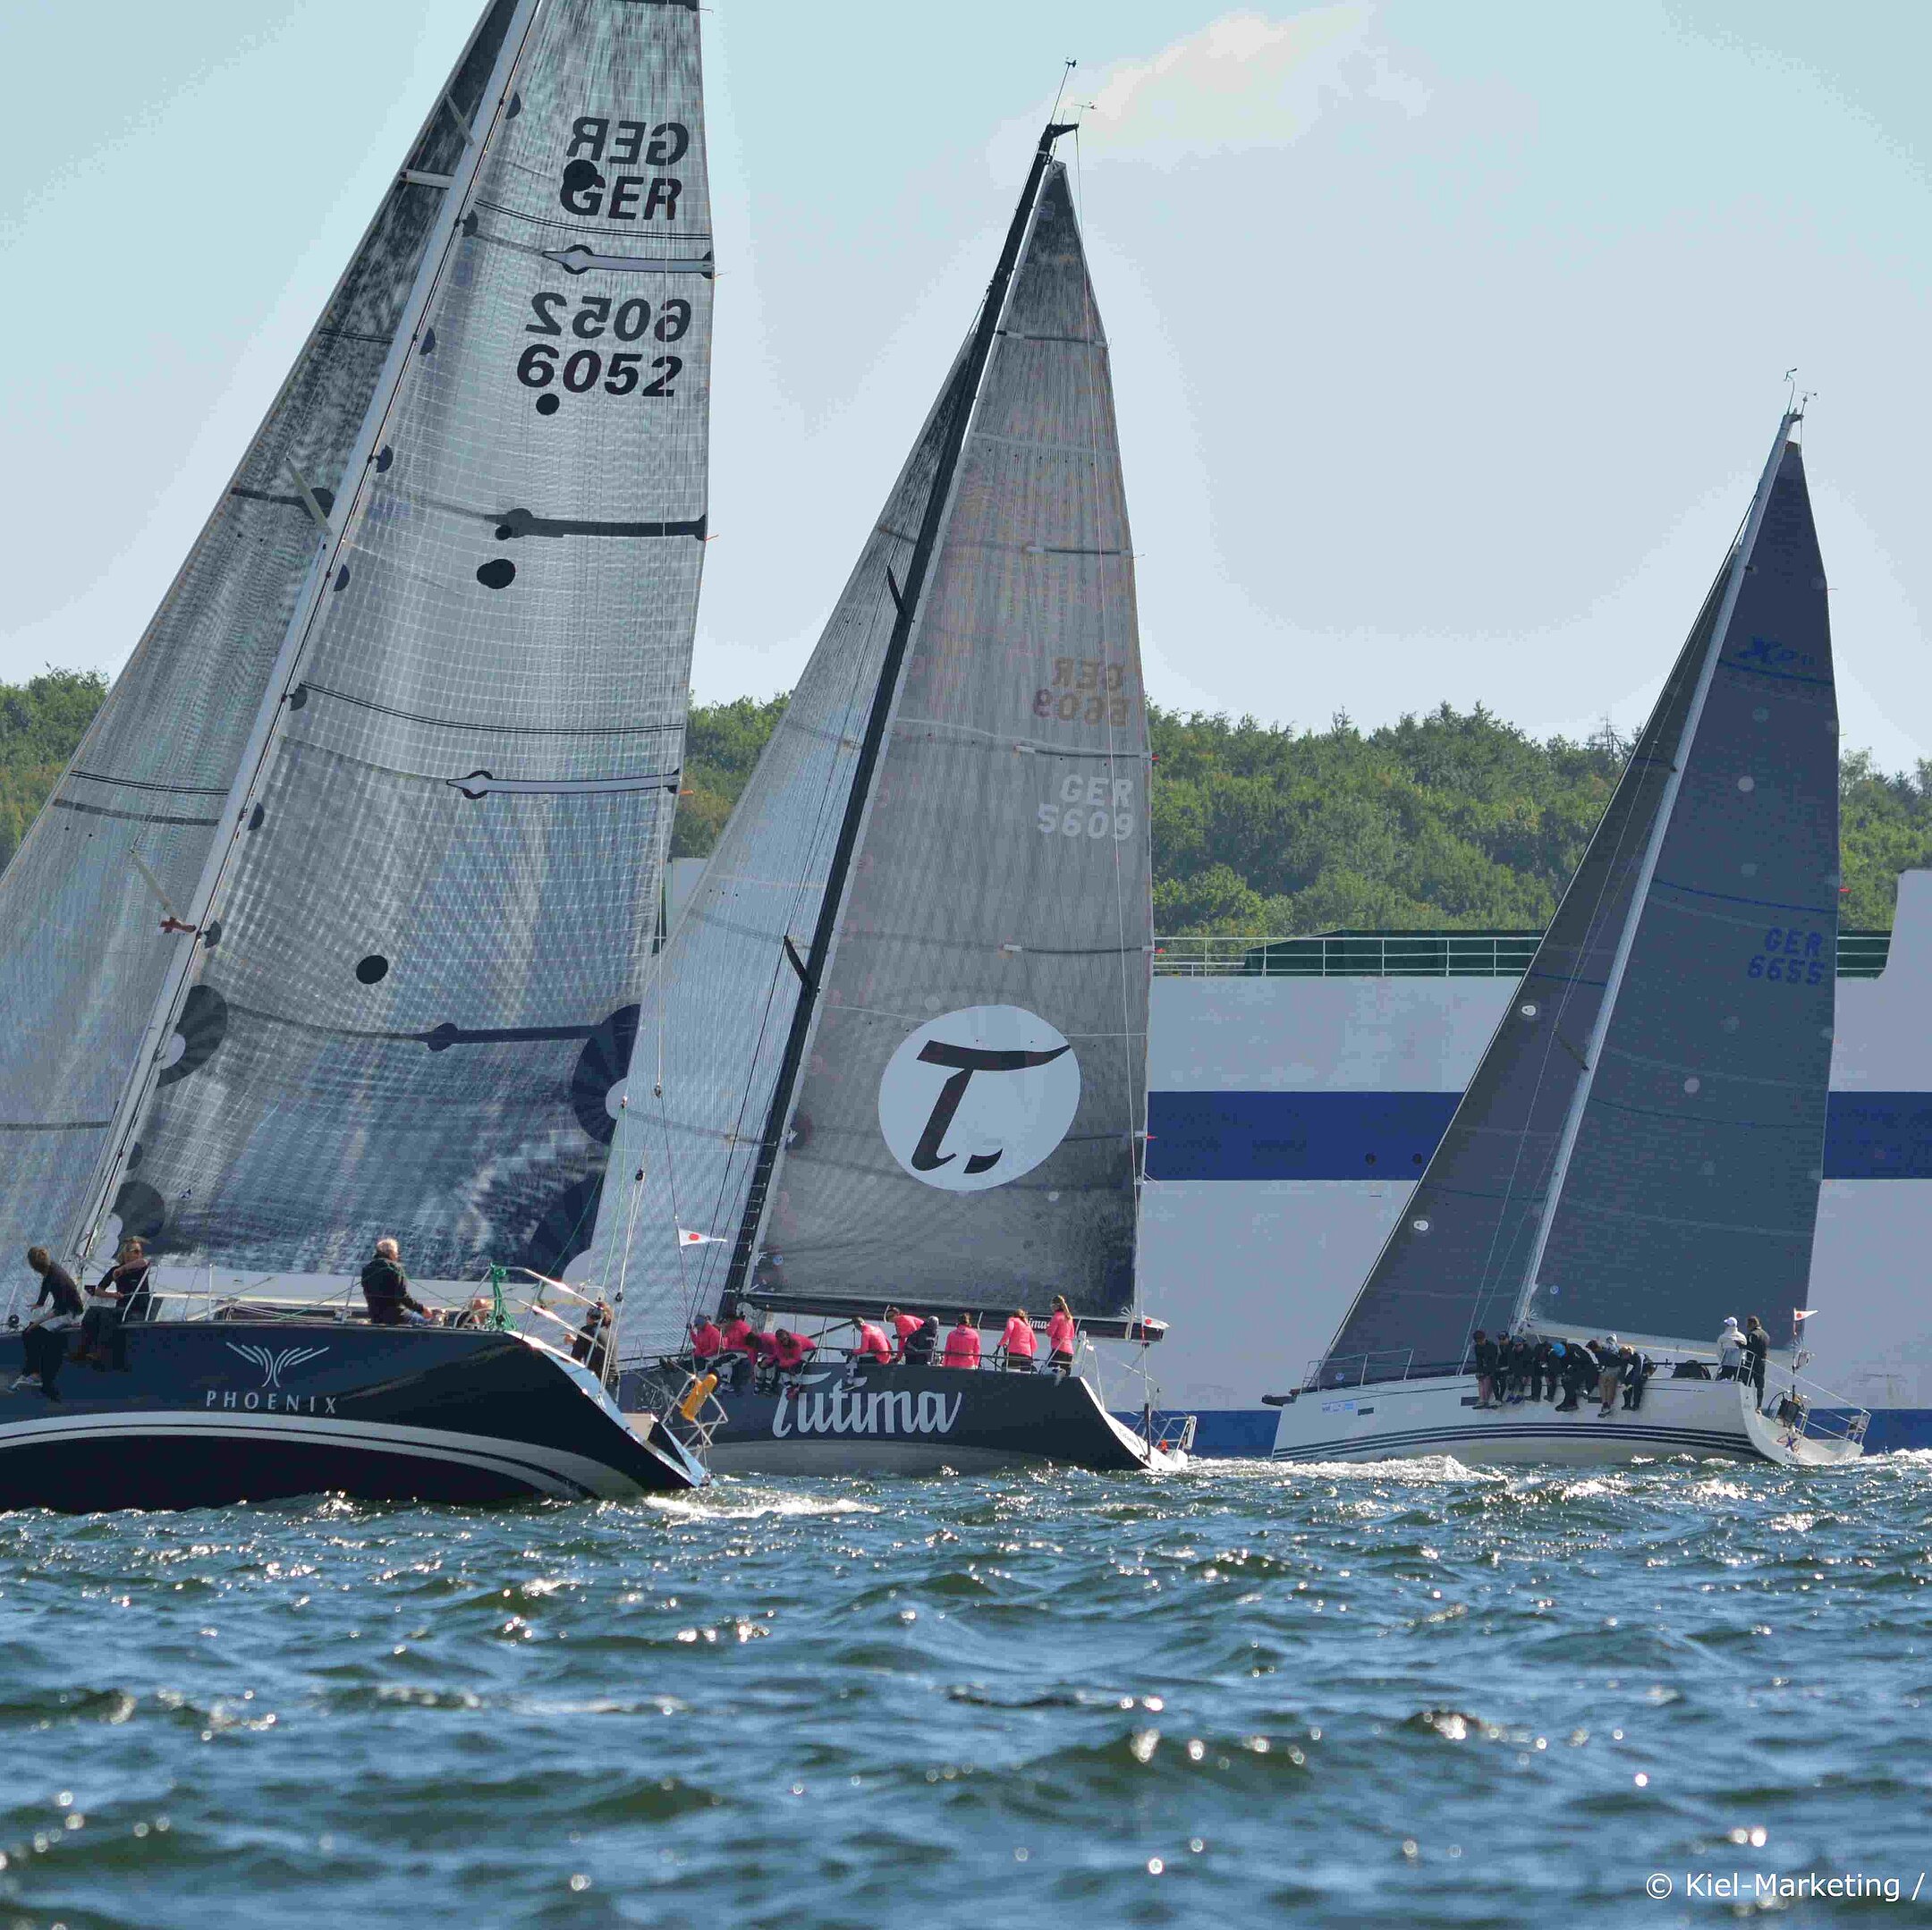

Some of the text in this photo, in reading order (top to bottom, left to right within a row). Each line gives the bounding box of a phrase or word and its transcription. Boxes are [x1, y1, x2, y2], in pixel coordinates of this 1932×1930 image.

[560, 172, 682, 220] GER
[517, 344, 682, 397] 6052
[1059, 775, 1134, 808] GER
[1038, 803, 1134, 842] 5609
[1765, 927, 1823, 958] GER
[1747, 954, 1826, 986] 6655
[206, 1390, 336, 1415] PHOENIX
[772, 1372, 962, 1438] Tutima
